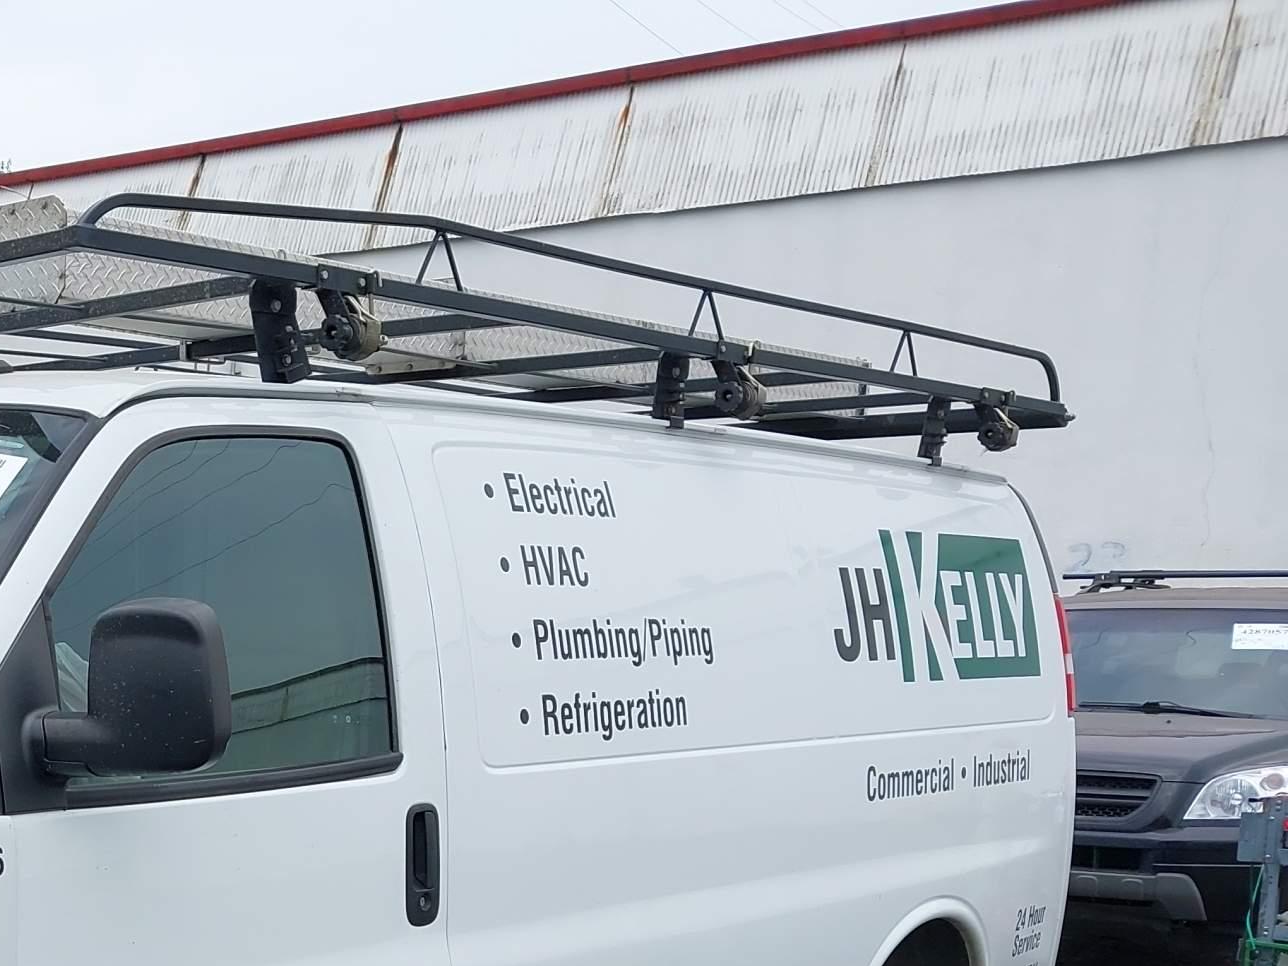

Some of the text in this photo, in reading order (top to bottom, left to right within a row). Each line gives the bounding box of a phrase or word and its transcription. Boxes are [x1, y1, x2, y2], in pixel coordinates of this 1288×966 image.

[503, 472, 616, 518] Electrical
[519, 545, 589, 587] HVAC
[532, 617, 714, 667] Plumbing/Piping
[541, 688, 688, 741] Refrigeration
[867, 749, 1031, 802] Commercial Industrial
[1015, 904, 1046, 931] 24 Hour
[1012, 930, 1041, 957] Service
